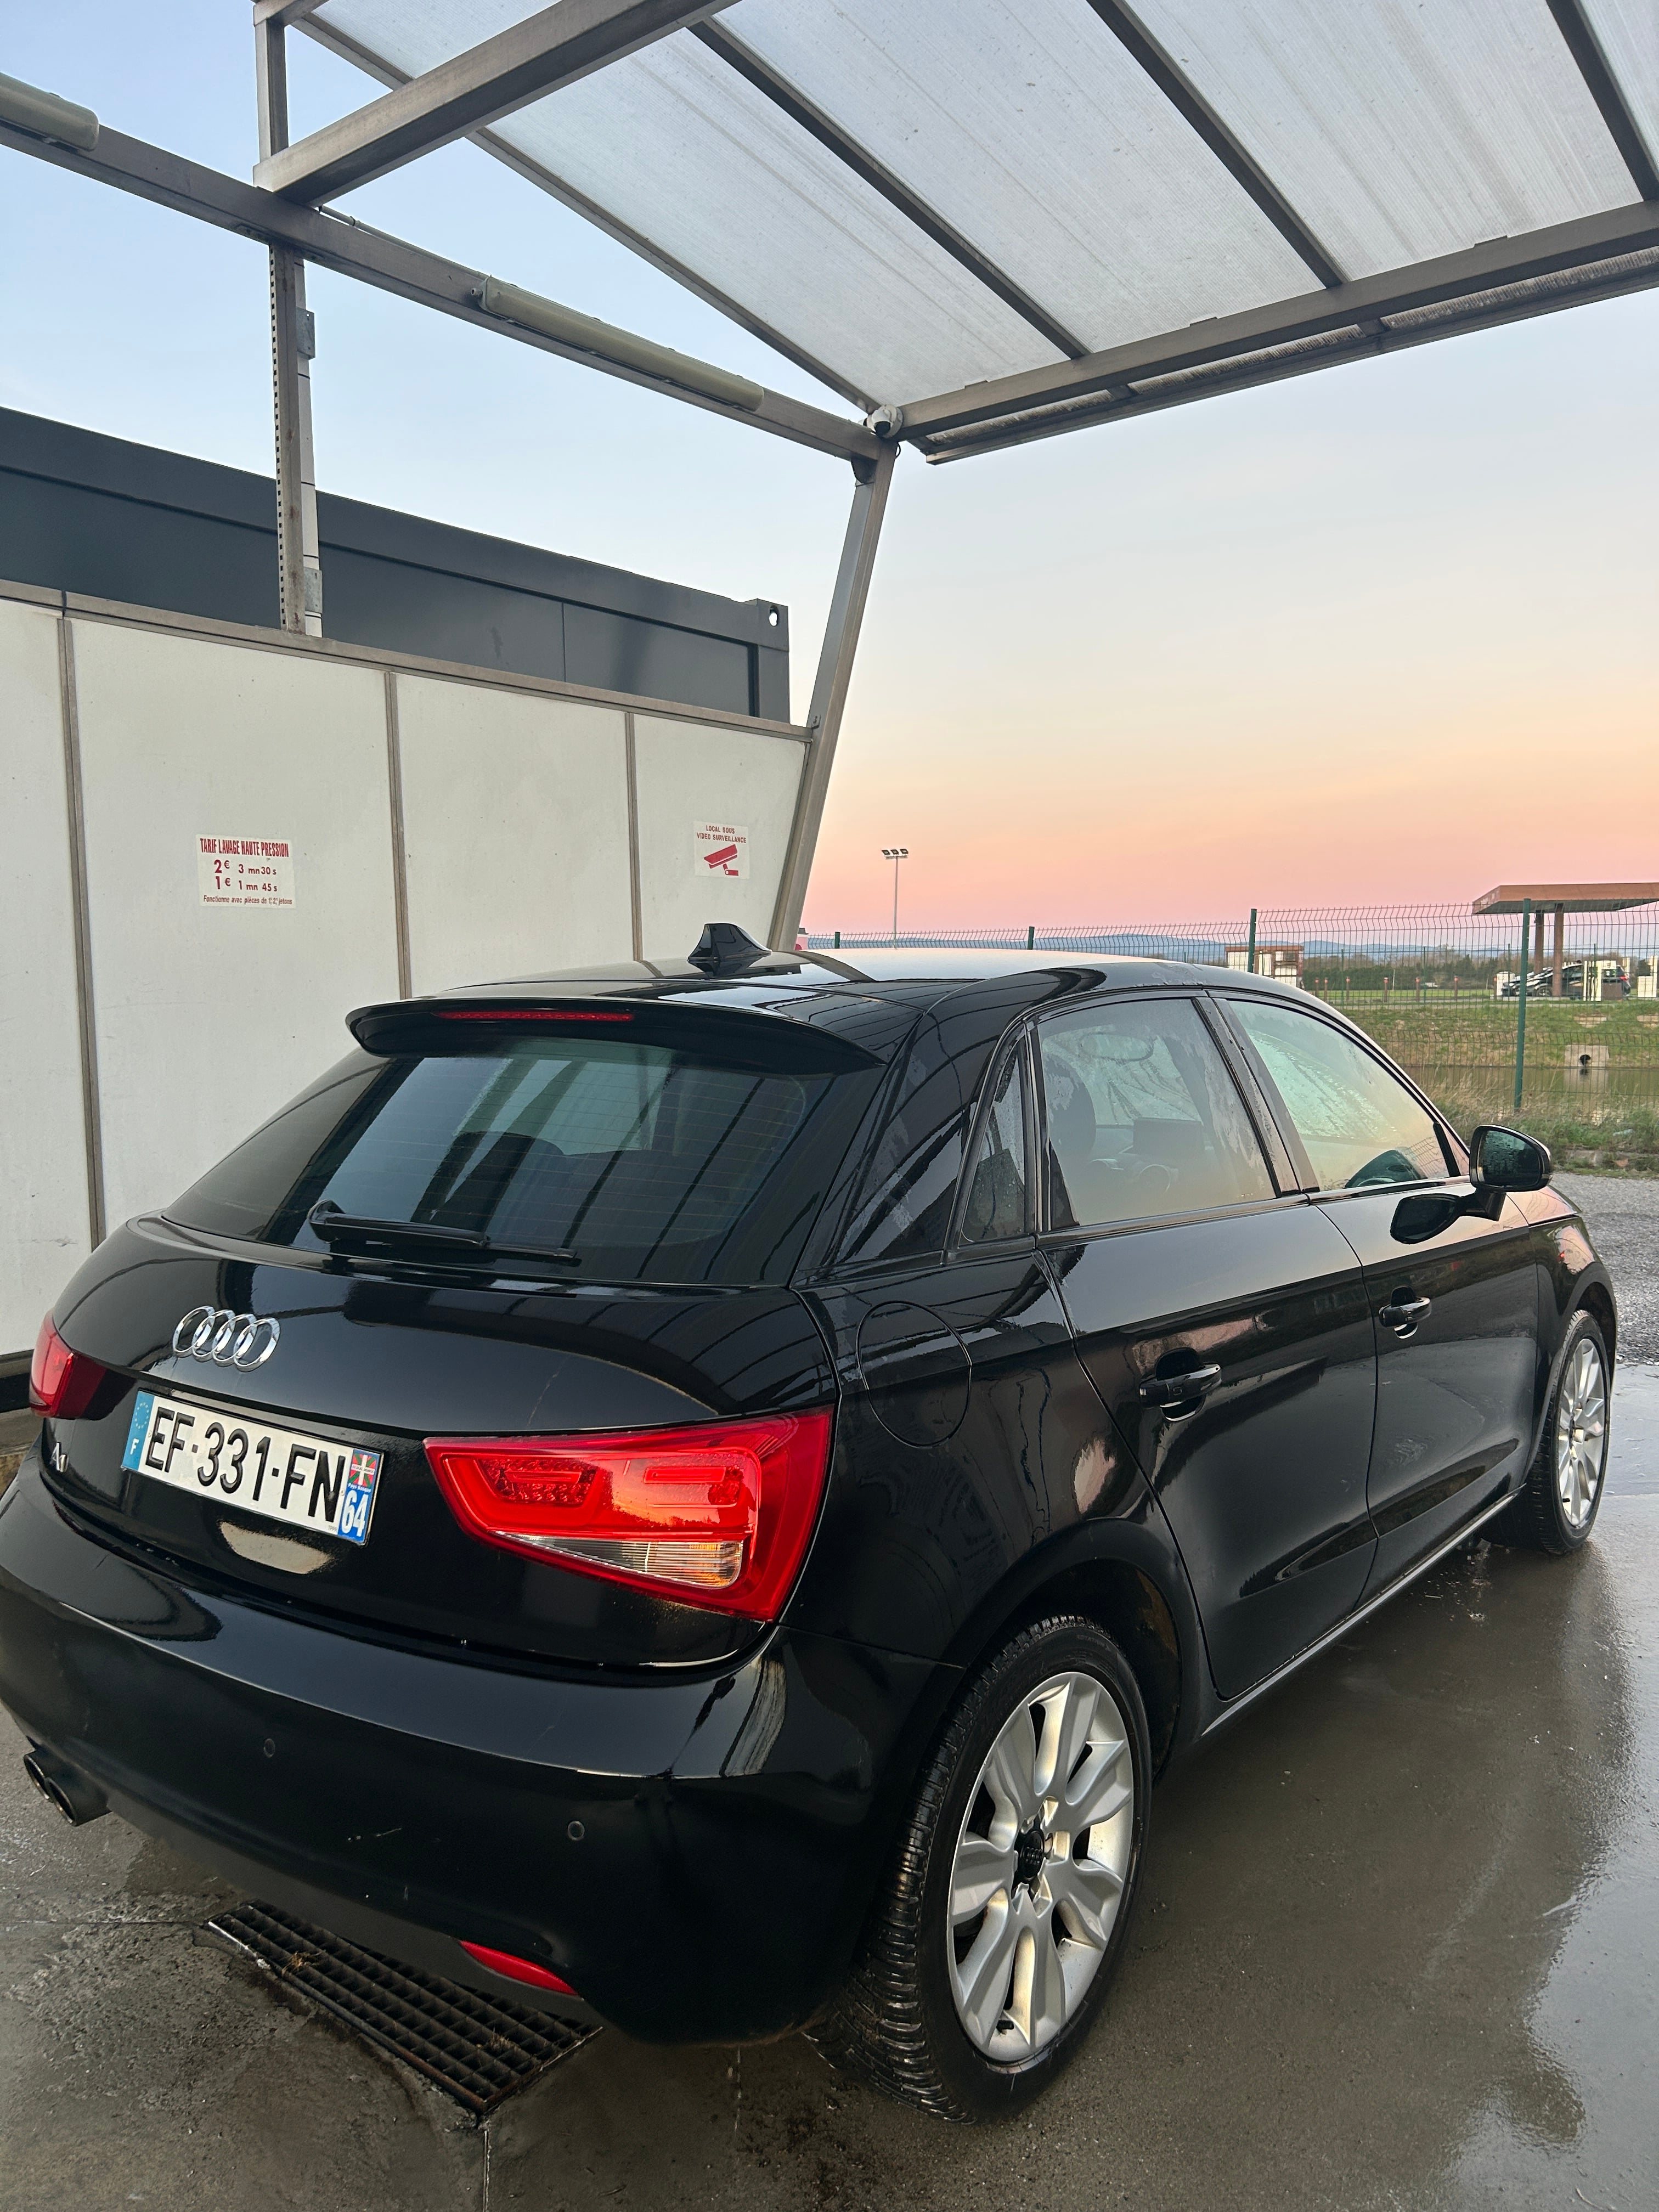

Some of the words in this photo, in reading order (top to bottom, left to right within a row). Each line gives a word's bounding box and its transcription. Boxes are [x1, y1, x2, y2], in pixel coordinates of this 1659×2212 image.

[713, 834, 746, 843] SURVEILLANCE
[200, 838, 217, 853] TARIF
[218, 839, 240, 855] LAVAGE
[241, 841, 259, 856] HAUTE
[261, 842, 289, 857] PRESSION
[238, 864, 244, 873] 3
[239, 880, 242, 890] 1
[262, 883, 272, 891] 45
[244, 896, 259, 905] pièces
[278, 898, 292, 906] jetons
[129, 1439, 139, 1455] F
[341, 1489, 369, 1537] 64
